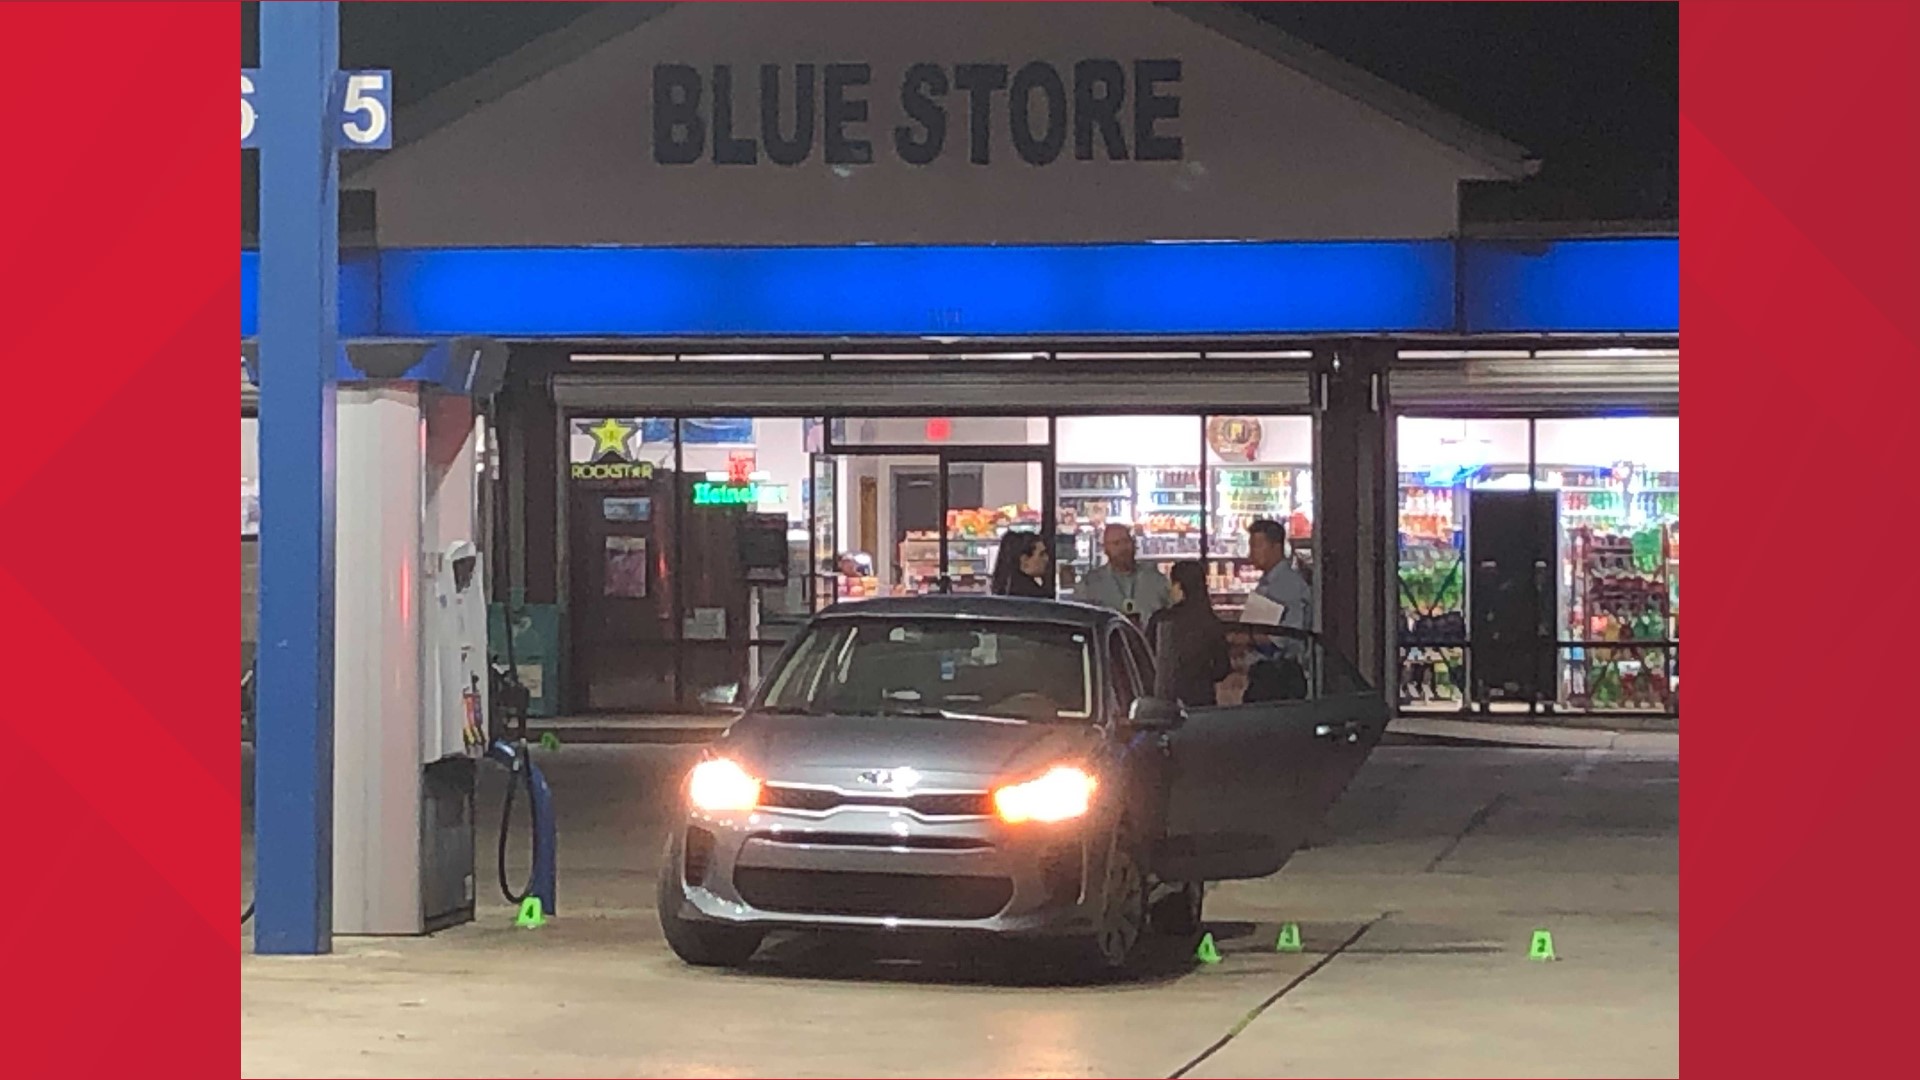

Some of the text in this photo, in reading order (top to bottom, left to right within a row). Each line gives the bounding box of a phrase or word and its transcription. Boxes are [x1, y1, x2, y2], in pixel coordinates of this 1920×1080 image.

[342, 75, 386, 143] 5
[652, 59, 1184, 166] BLUE STORE
[693, 482, 788, 504] Heinekn
[525, 903, 534, 919] 4
